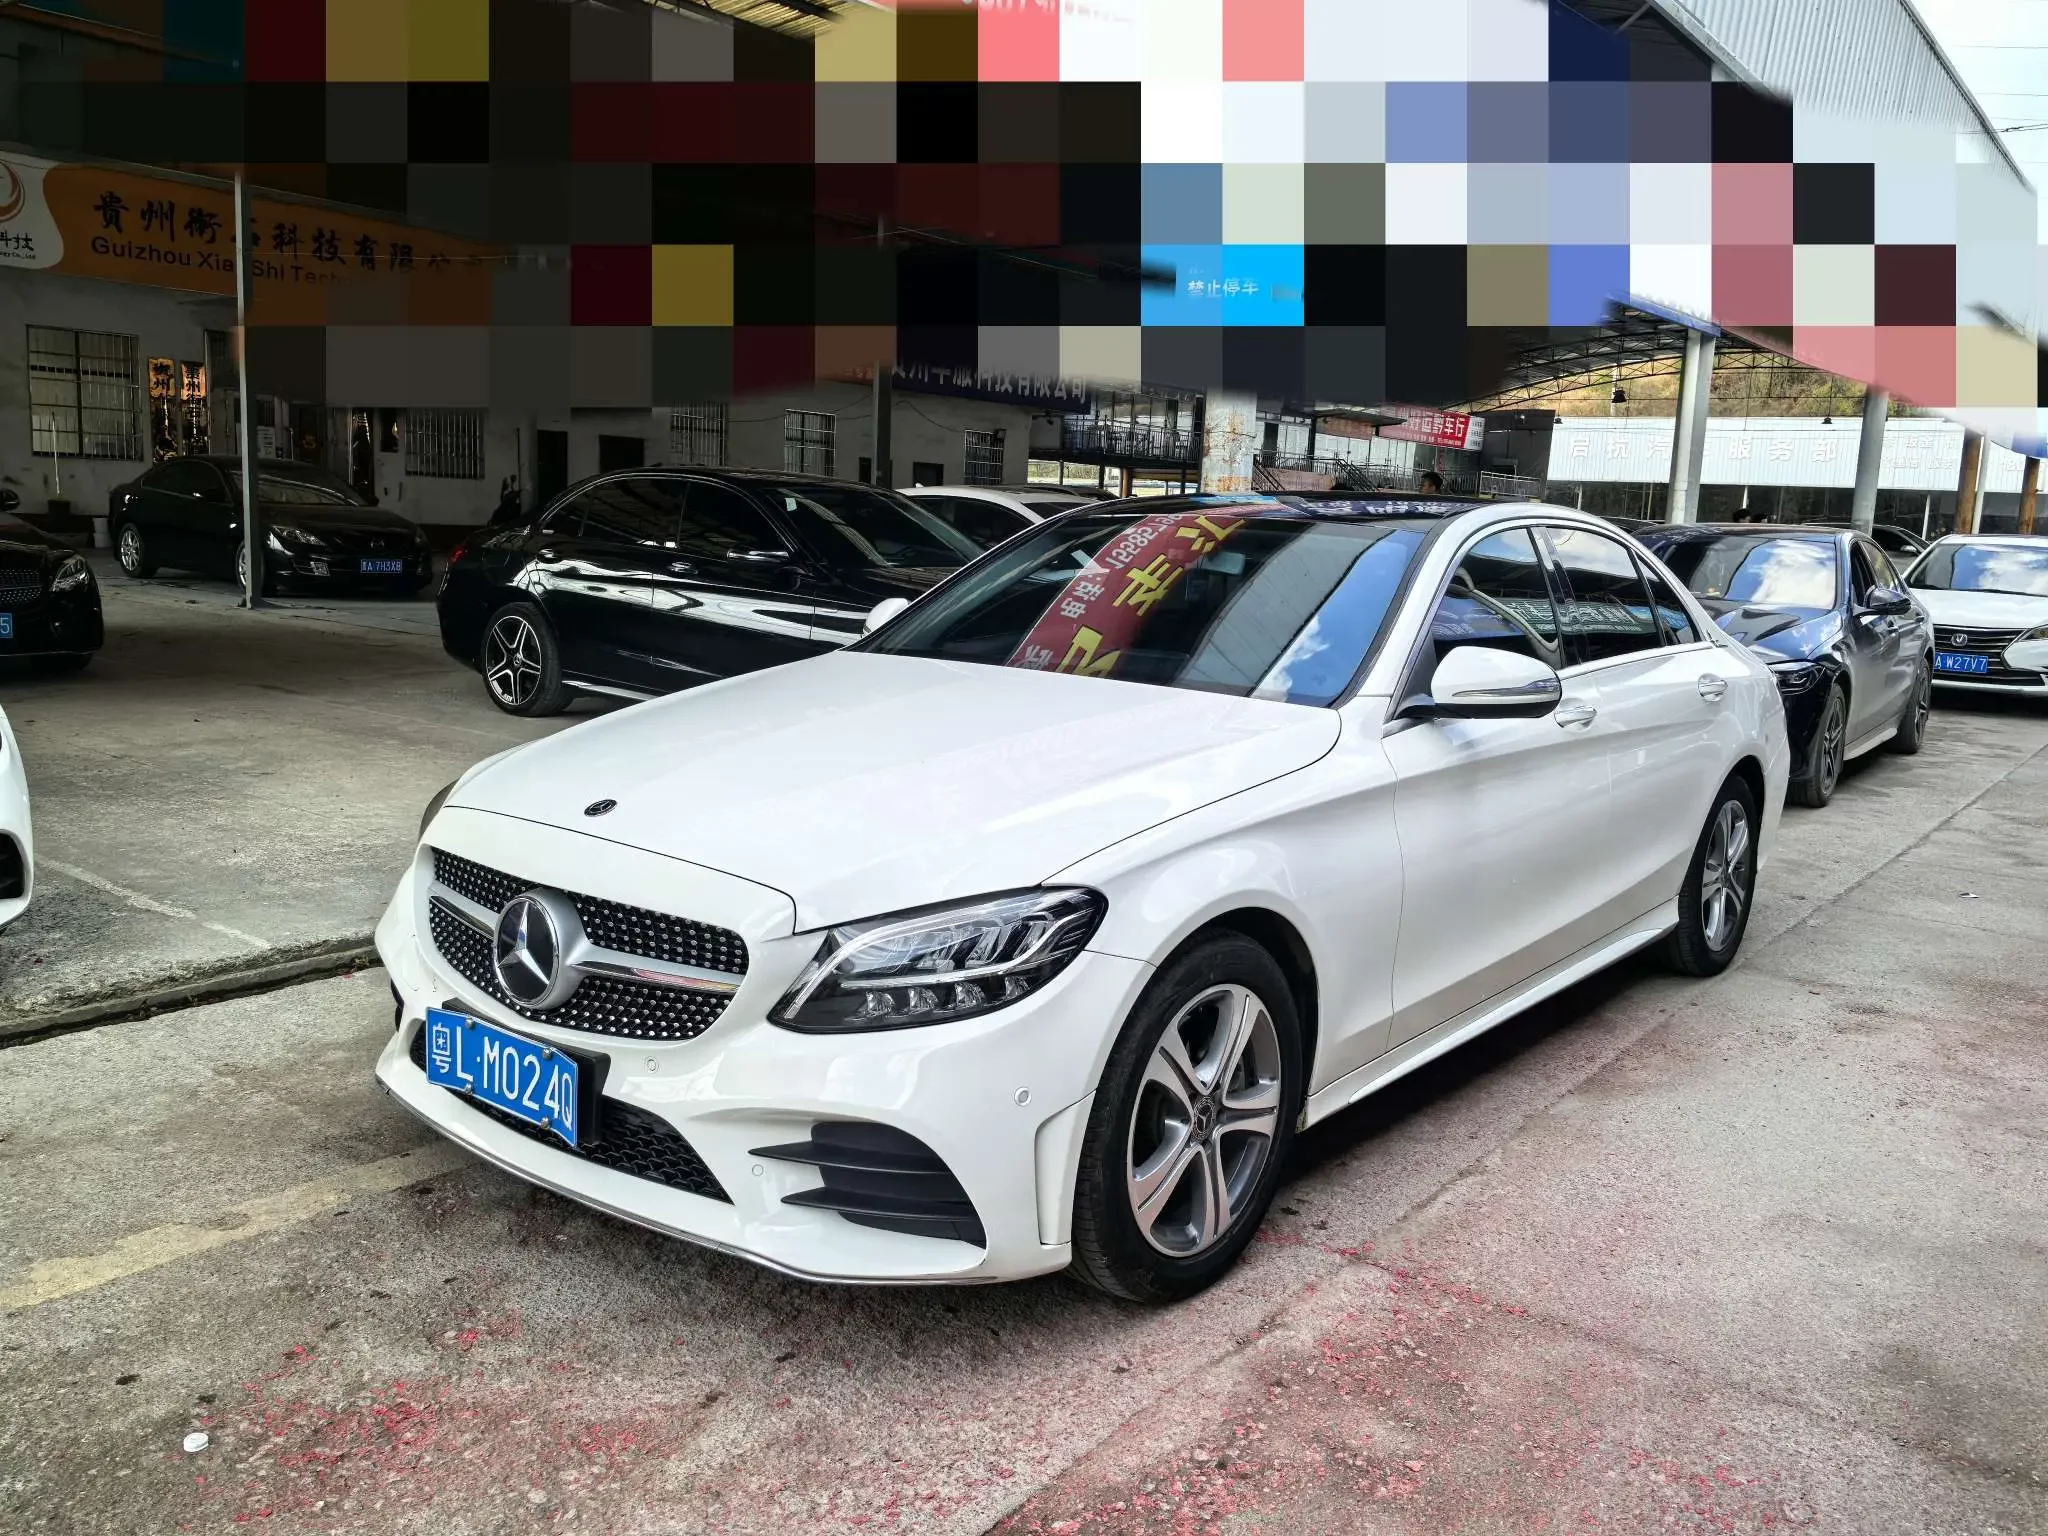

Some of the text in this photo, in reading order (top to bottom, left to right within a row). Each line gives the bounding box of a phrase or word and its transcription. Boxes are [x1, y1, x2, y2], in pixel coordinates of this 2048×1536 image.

[92, 236, 191, 266] Guizhou
[197, 250, 235, 273] Xia
[252, 260, 284, 281] Shi
